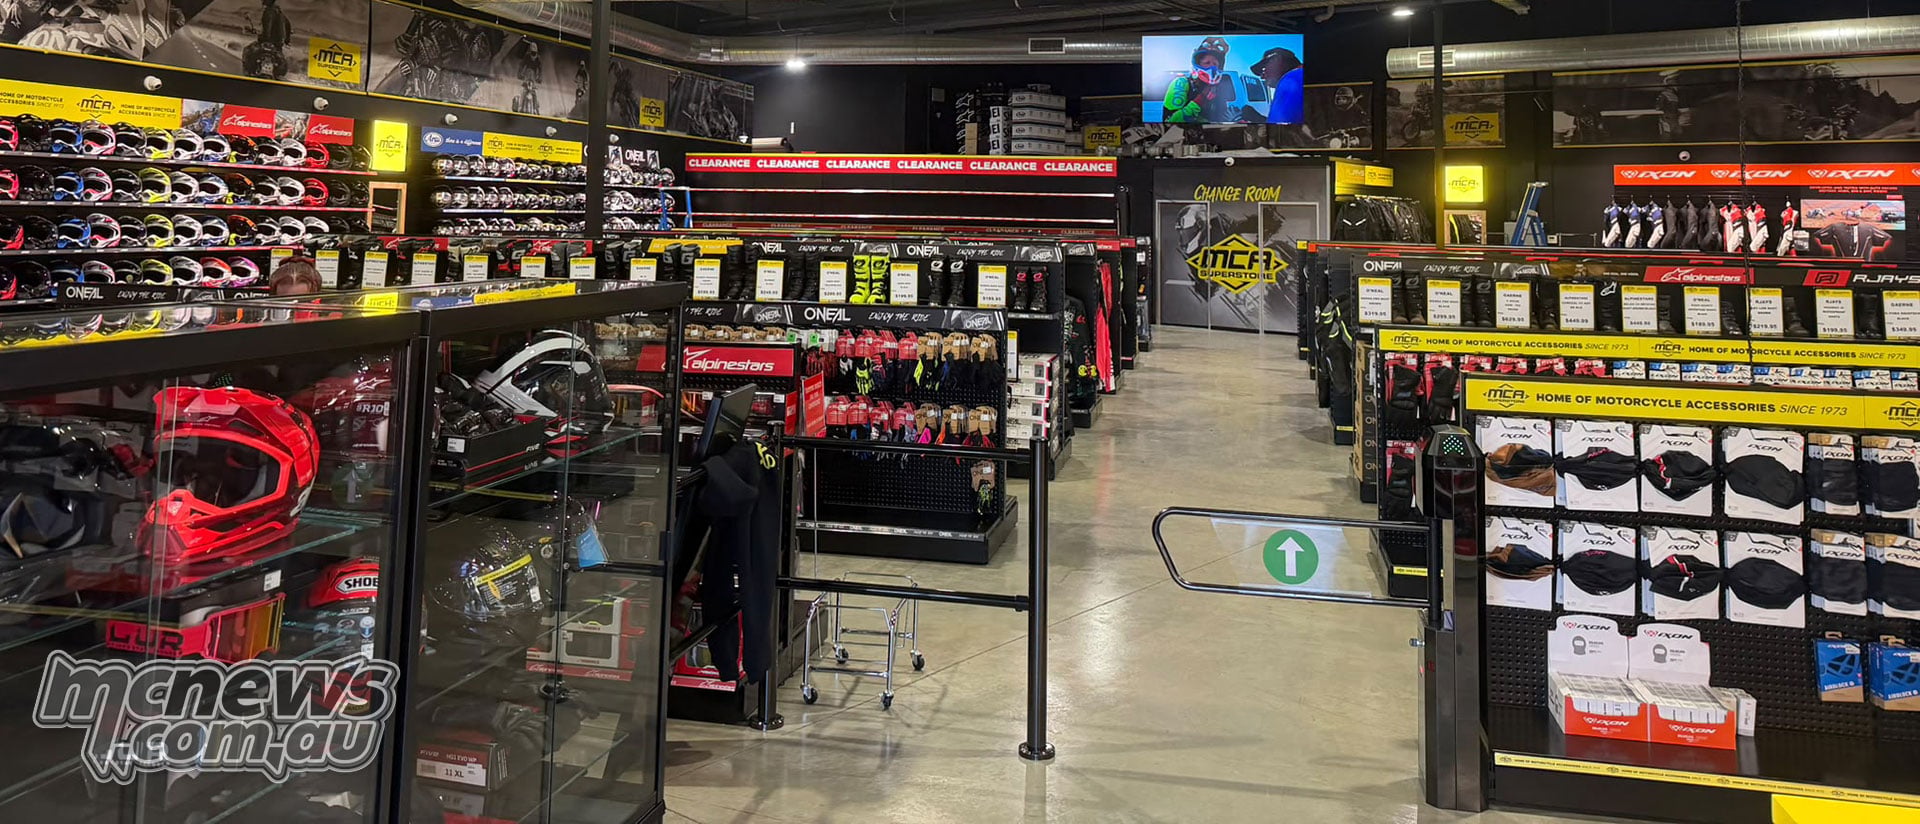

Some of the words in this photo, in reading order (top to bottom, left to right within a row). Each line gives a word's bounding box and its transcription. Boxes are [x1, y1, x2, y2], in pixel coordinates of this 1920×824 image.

[318, 50, 353, 66] MCA
[80, 99, 113, 110] MCA
[645, 104, 661, 115] MCA
[1455, 120, 1490, 131] MCA
[1090, 132, 1115, 141] MCA
[379, 139, 401, 150] MCA
[687, 158, 751, 168] CLEARANCE
[757, 159, 820, 169] CLEARANCE
[825, 160, 891, 170] CLEARANCE
[897, 160, 963, 171] CLEARANCE
[970, 161, 1038, 172] CLEARANCE
[1043, 162, 1114, 172] CLEARANCE
[1637, 170, 1697, 181] IXON
[1731, 170, 1792, 181] IXON
[1826, 169, 1896, 181] IXON
[1451, 180, 1477, 188] MCA
[1193, 184, 1241, 203] CHANGE
[1245, 185, 1283, 203] ROOM
[1200, 249, 1273, 271] MCA
[1200, 269, 1274, 280] SUPERSTORE
[1681, 273, 1742, 284] alpinestars
[1852, 273, 1920, 284] RJAYS
[868, 312, 893, 323] ENJOY
[895, 312, 910, 322] THE
[912, 313, 930, 322] RIDE
[1393, 335, 1419, 344] MCA
[1466, 339, 1522, 348] MOTORCYCLE
[1524, 340, 1583, 350] ACCESSORIES
[1611, 343, 1630, 351] 1973
[1654, 343, 1681, 351] MCA
[1716, 346, 1729, 354] OF
[1730, 348, 1791, 357] MOTORCYCLE
[1794, 350, 1857, 359] ACCESSORIES
[1859, 352, 1885, 360] SINCE
[1887, 352, 1906, 360] 1973
[691, 358, 775, 373] alpinestars
[1487, 388, 1525, 400] MCA
[1536, 393, 1572, 403] HOME
[1575, 394, 1591, 405] OF
[1596, 396, 1682, 409] MOTORCYCLE
[1687, 400, 1776, 412] ACCESSORIES
[1779, 404, 1817, 415] SINCE
[1820, 406, 1848, 416] 1973
[1576, 622, 1611, 632] IXON
[1657, 632, 1694, 641] IXON
[1595, 718, 1630, 727] IXON
[1682, 726, 1717, 735] IXON
[454, 770, 465, 778] XL
